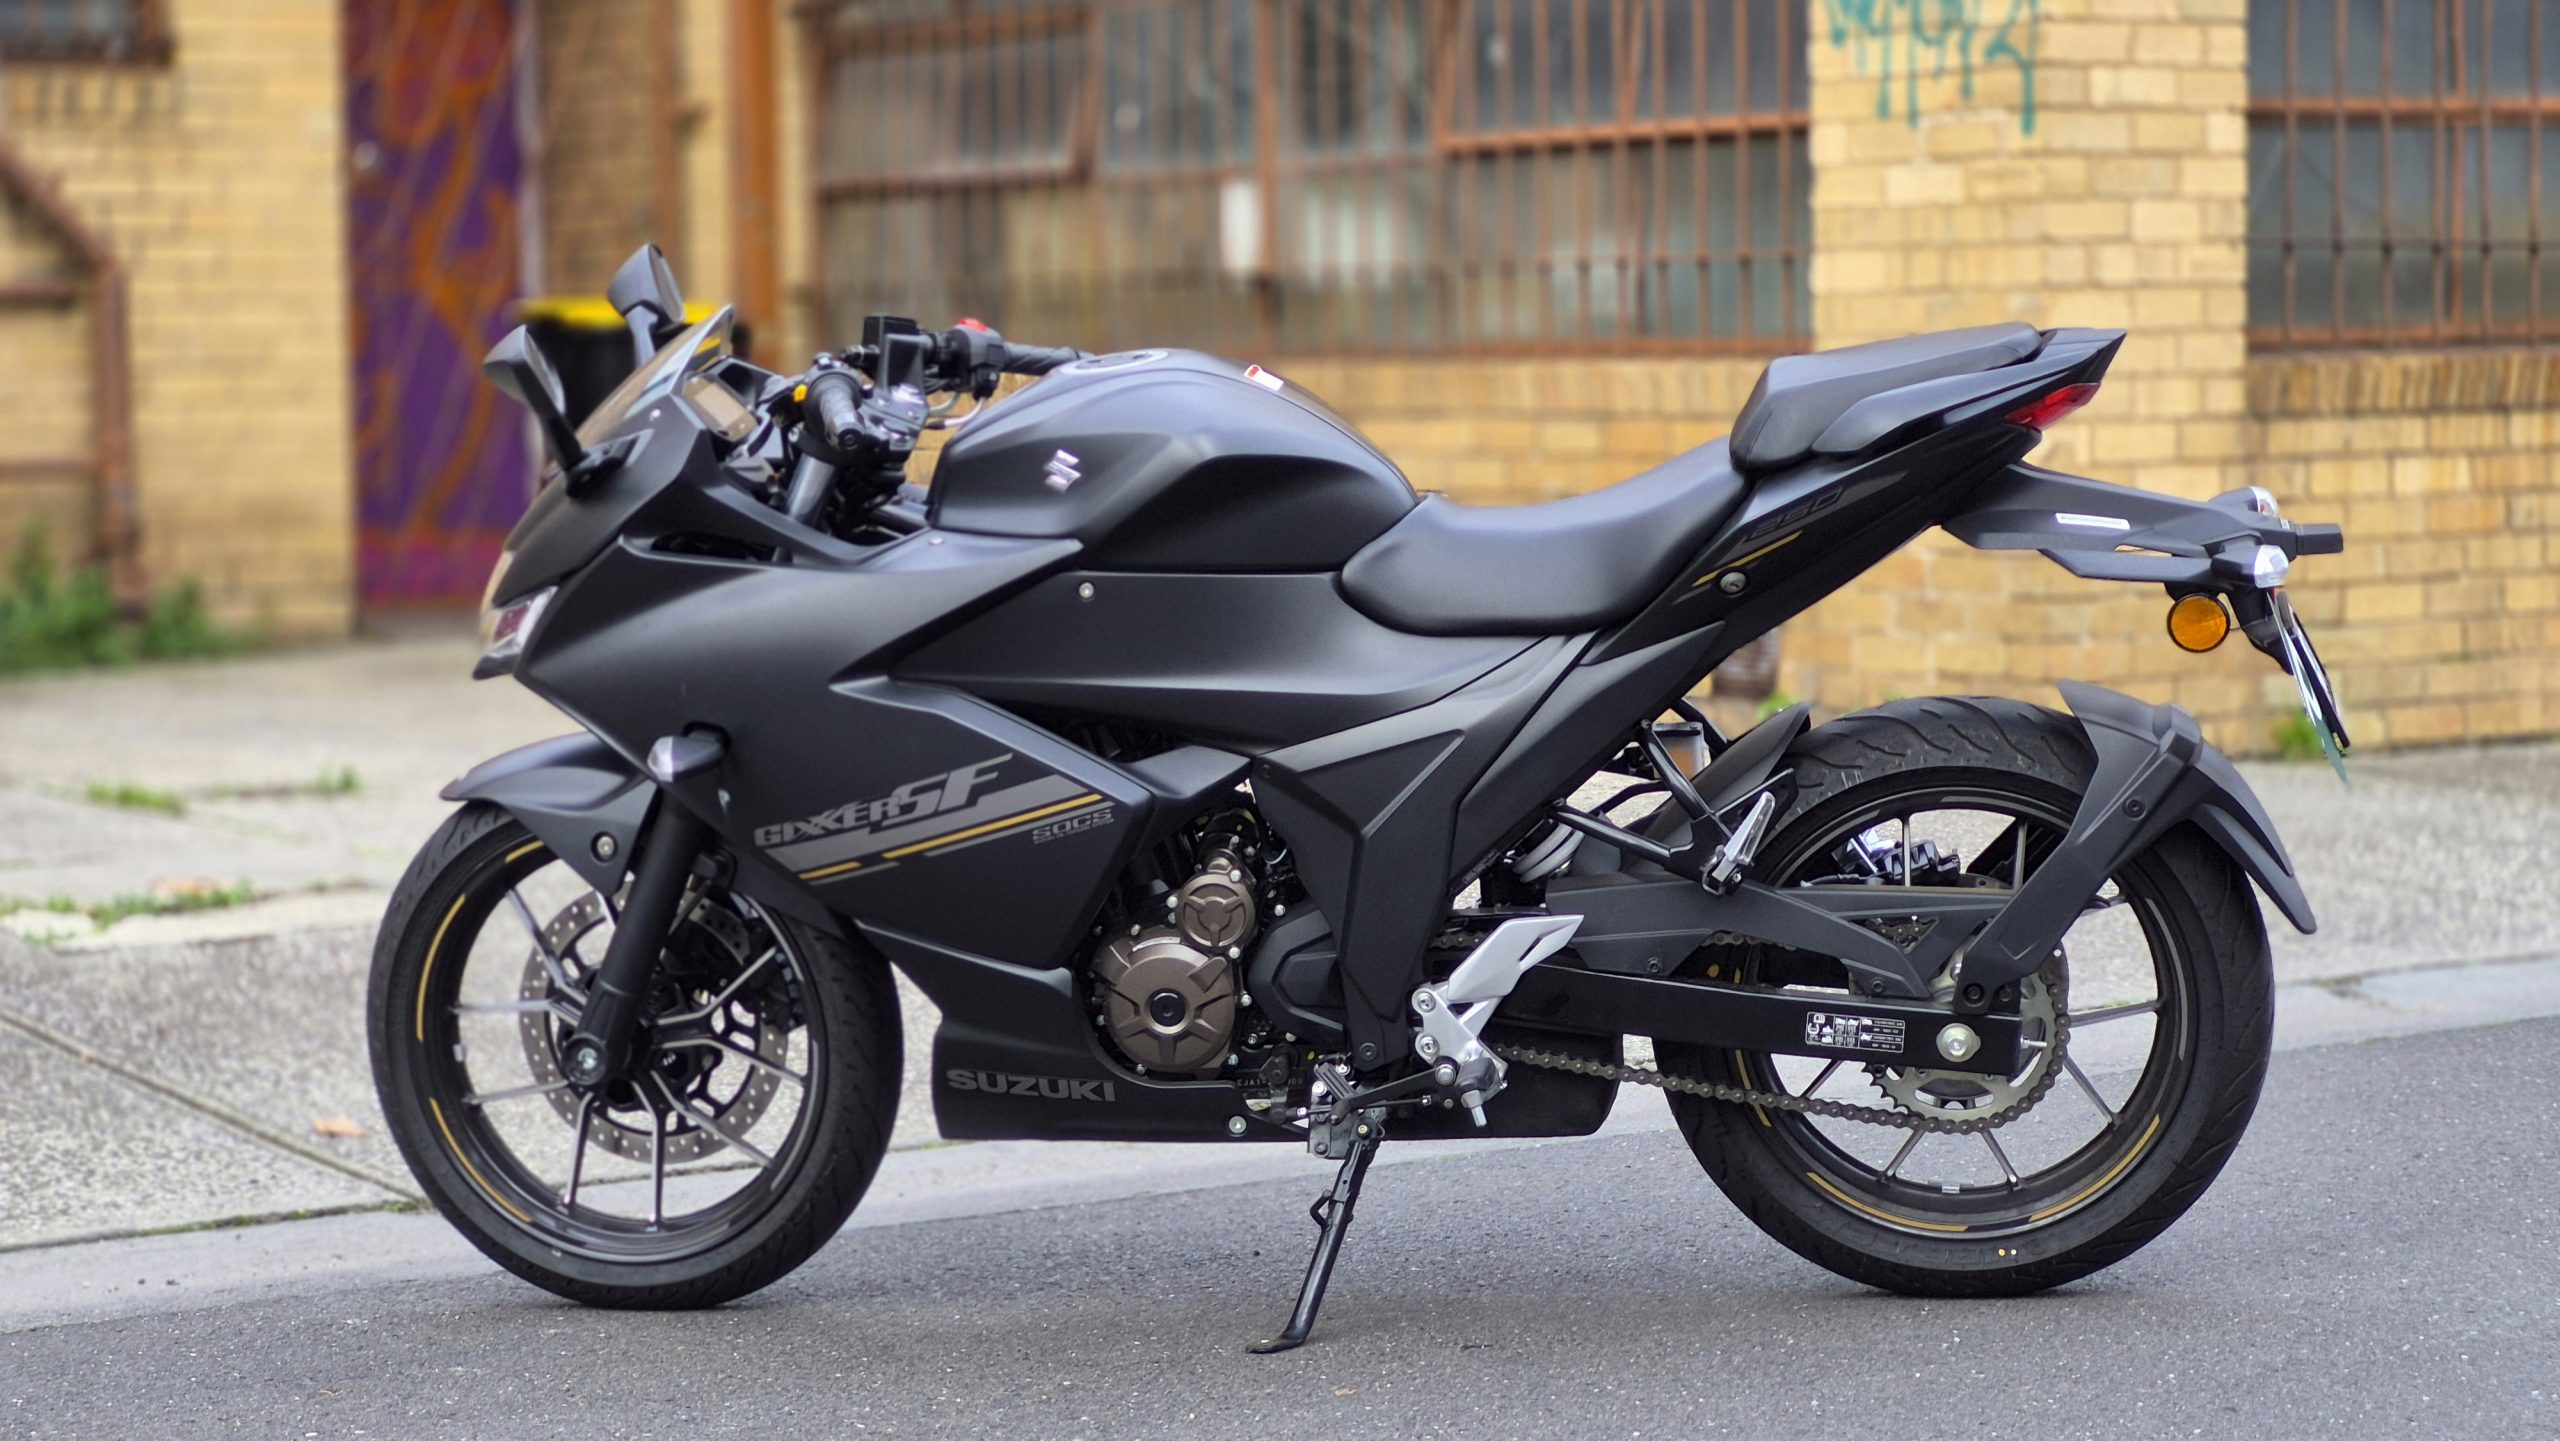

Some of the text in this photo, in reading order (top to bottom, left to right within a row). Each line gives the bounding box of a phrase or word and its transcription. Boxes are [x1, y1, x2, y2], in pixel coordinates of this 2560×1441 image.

[754, 753, 1013, 846] GIXXER SF
[1032, 809, 1112, 841] SOCS
[946, 1068, 1116, 1102] SUZUKI
